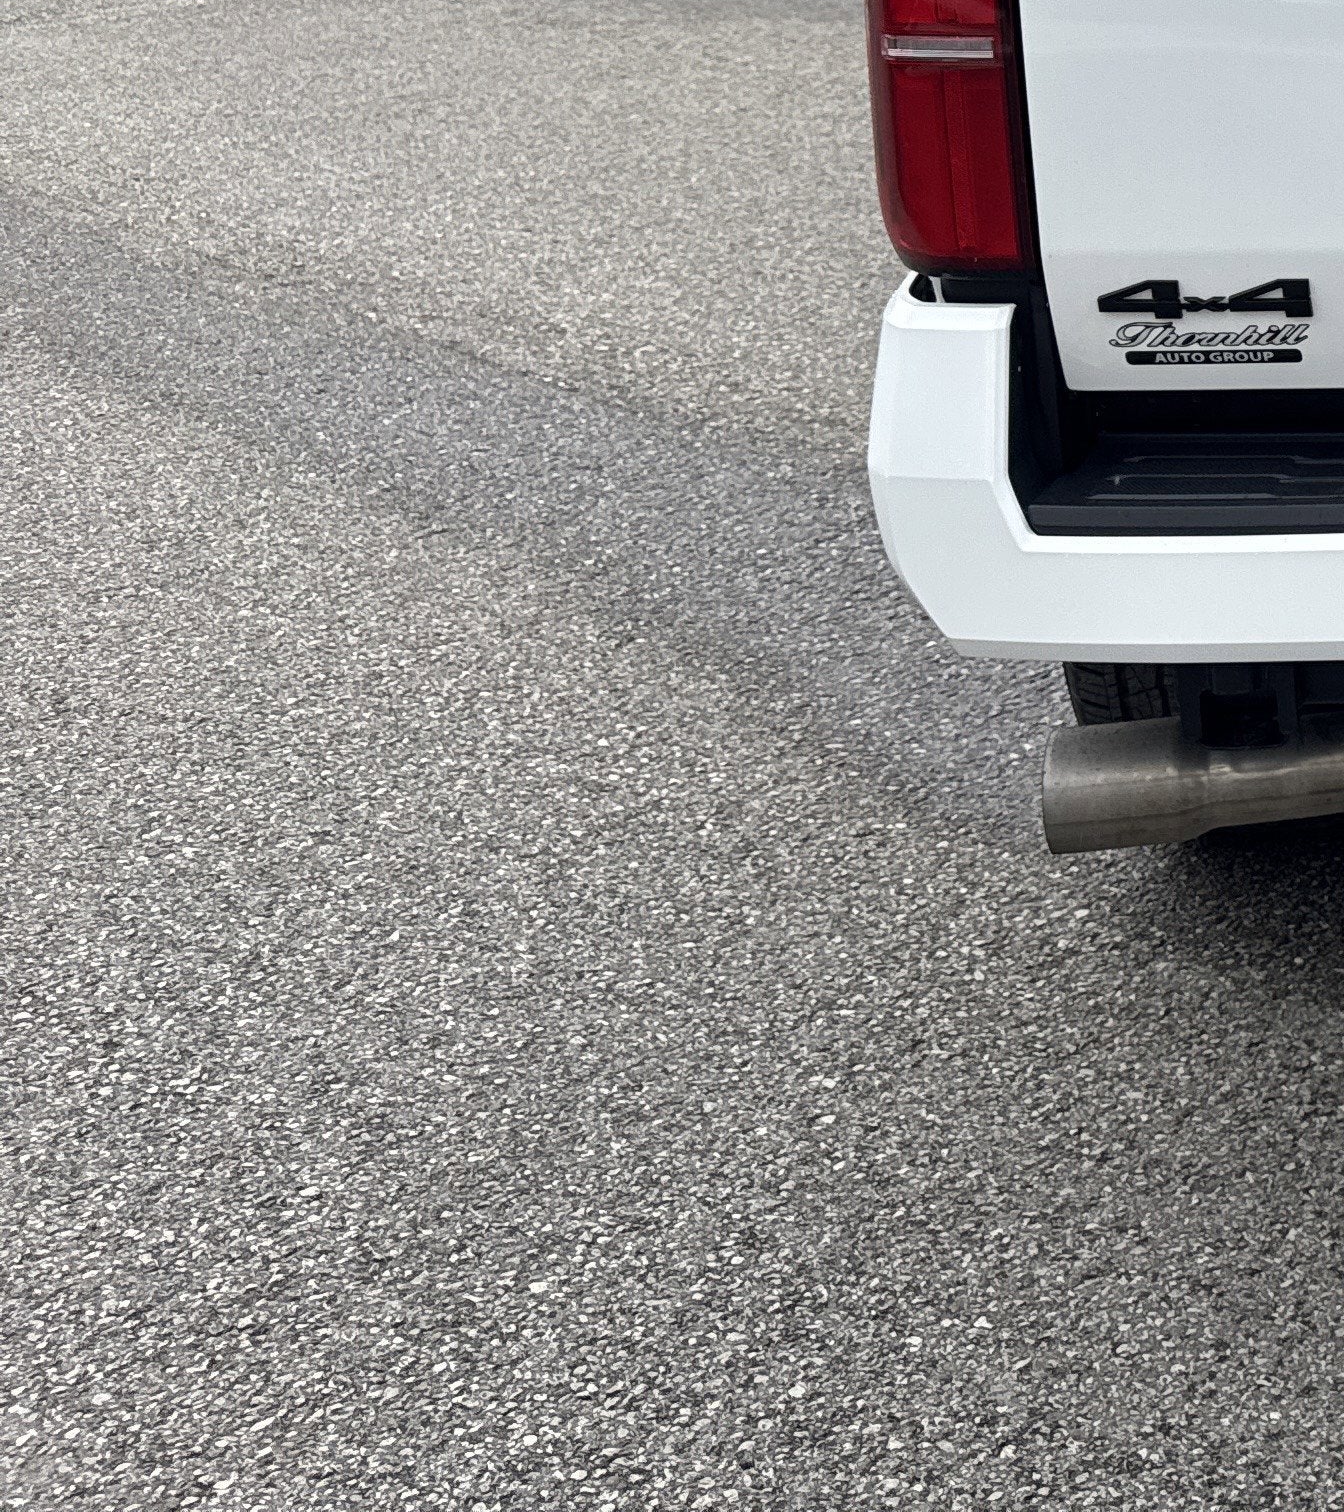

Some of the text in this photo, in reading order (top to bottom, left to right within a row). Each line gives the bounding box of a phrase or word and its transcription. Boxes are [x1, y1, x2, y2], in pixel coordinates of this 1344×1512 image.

[1097, 278, 1314, 319] 4x4
[1109, 321, 1311, 348] Thornhill
[1155, 351, 1275, 364] AUTO GROUP
